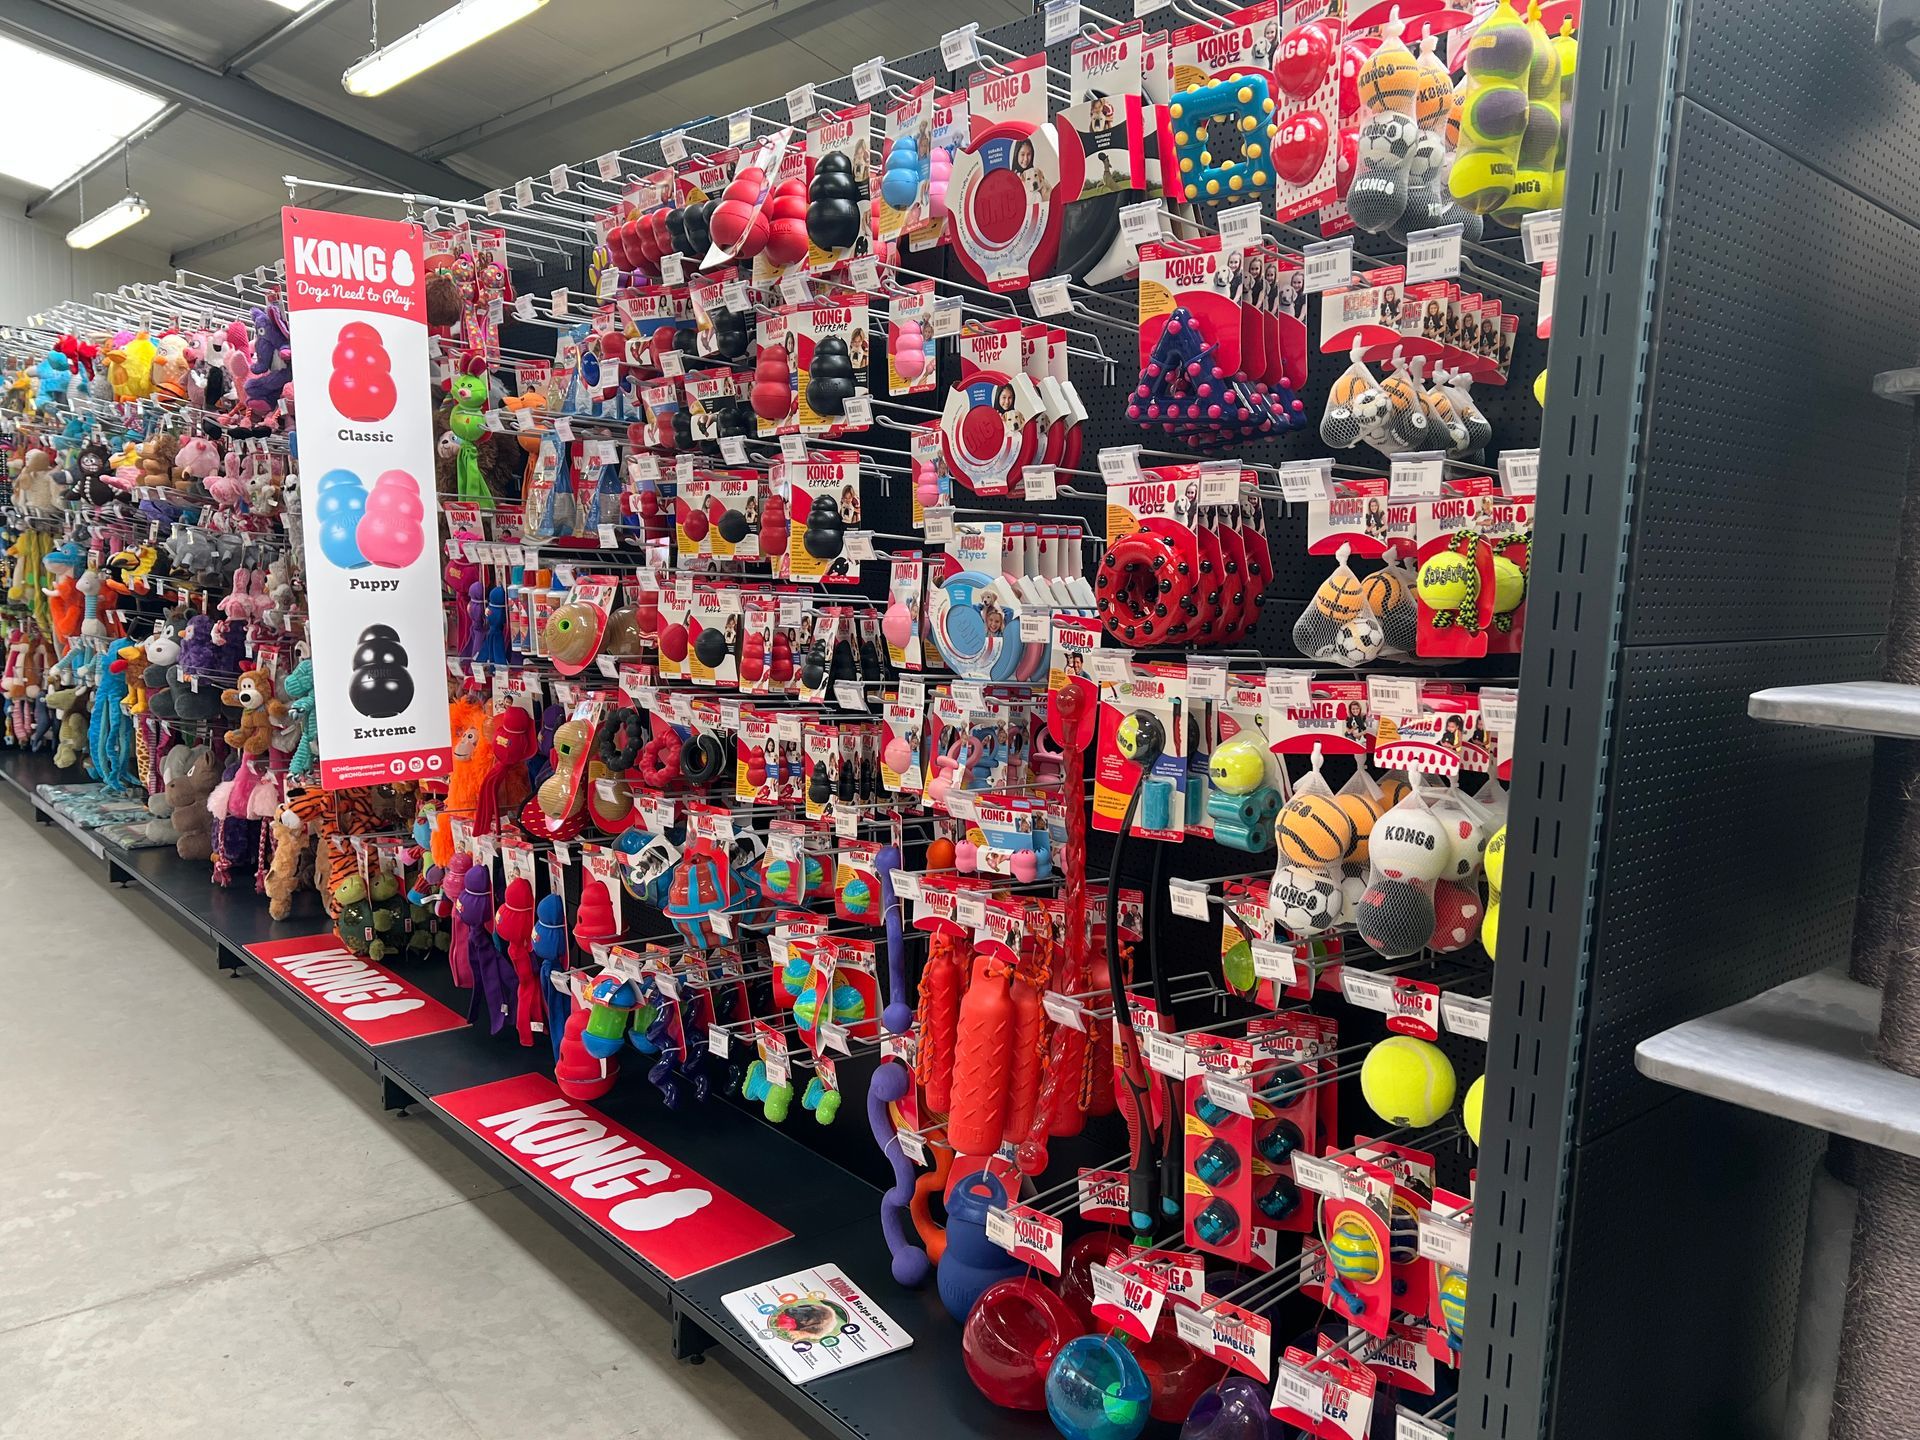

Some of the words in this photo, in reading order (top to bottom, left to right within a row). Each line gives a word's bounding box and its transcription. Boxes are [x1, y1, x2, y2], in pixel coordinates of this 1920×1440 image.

[1197, 32, 1239, 63] KONG
[1081, 49, 1117, 72] KONG
[1210, 53, 1241, 69] dotz
[1087, 62, 1120, 79] FLYER
[1359, 67, 1386, 87] KONG
[983, 77, 1019, 105] KONG
[996, 97, 1018, 112] Flyer
[896, 105, 917, 126] KONG
[820, 126, 845, 145] KONG
[822, 136, 850, 152] EXTREME
[699, 169, 718, 182] KONG
[1355, 178, 1386, 192] KONG
[1512, 181, 1533, 195] ONG
[293, 236, 387, 283] KONG
[1165, 256, 1204, 279] KONG
[1176, 274, 1205, 288] dotz
[296, 280, 332, 302] Dogs
[332, 284, 365, 301] Need
[367, 288, 382, 302] to
[700, 286, 719, 301] KONG
[629, 298, 649, 313] KONG
[898, 298, 918, 311] KONG
[813, 309, 843, 326] KONG
[766, 318, 783, 334] KONG
[815, 324, 849, 334] EXTREME
[972, 335, 999, 352] KONG
[979, 350, 1003, 365] Flyer
[521, 370, 540, 381] KONG
[697, 382, 713, 394] KONG
[338, 430, 394, 442] Classic
[918, 433, 936, 447] KONG
[807, 465, 835, 482] KONG
[686, 482, 704, 493] KONG
[721, 482, 742, 493] KONG
[809, 480, 841, 488] EXTREME
[1129, 486, 1165, 509] KONG
[1139, 501, 1165, 518] dotz
[1329, 499, 1363, 518] KONG
[1387, 507, 1409, 523] ONG
[1432, 502, 1465, 519] KONG
[450, 511, 471, 522] KONG
[495, 514, 517, 526] KONG
[961, 536, 985, 551] KONG
[957, 549, 987, 562] Flyer
[895, 564, 913, 580] KONG
[350, 578, 399, 594] Puppy
[672, 602, 686, 612] Ball
[751, 612, 764, 622] KONG
[1060, 630, 1086, 645] KONG
[1133, 680, 1158, 693] KONG
[1237, 691, 1256, 703] KONG
[699, 711, 714, 721] KONG
[890, 705, 909, 717] KONG
[1288, 702, 1332, 721] KONG
[746, 722, 765, 734] KONG
[1298, 718, 1337, 729] SPORT
[354, 726, 416, 739] Extreme
[811, 736, 827, 748] KONG
[332, 763, 385, 773] KONGcompany.com
[339, 770, 385, 780] @KONGcompany
[981, 808, 1005, 822] KONG
[1385, 825, 1425, 847] KONG
[591, 857, 607, 869] KONG
[850, 850, 865, 861] KONG
[925, 891, 949, 907] KONG
[1273, 884, 1311, 908] KONG
[1024, 911, 1045, 924] ONG
[1236, 904, 1255, 918] KONG
[788, 923, 808, 934] KONG
[986, 913, 1007, 930] KONG
[272, 948, 404, 1004] KONG
[1394, 990, 1424, 1009] KONG
[477, 1098, 672, 1200] KONG
[1015, 1217, 1045, 1243] KONG
[1019, 1236, 1048, 1253] JUMBLER
[826, 1276, 855, 1298] KONG
[853, 1300, 872, 1317] Helps
[1212, 1327, 1257, 1357] JUMBLER
[1363, 1346, 1417, 1372] JUMBLER
